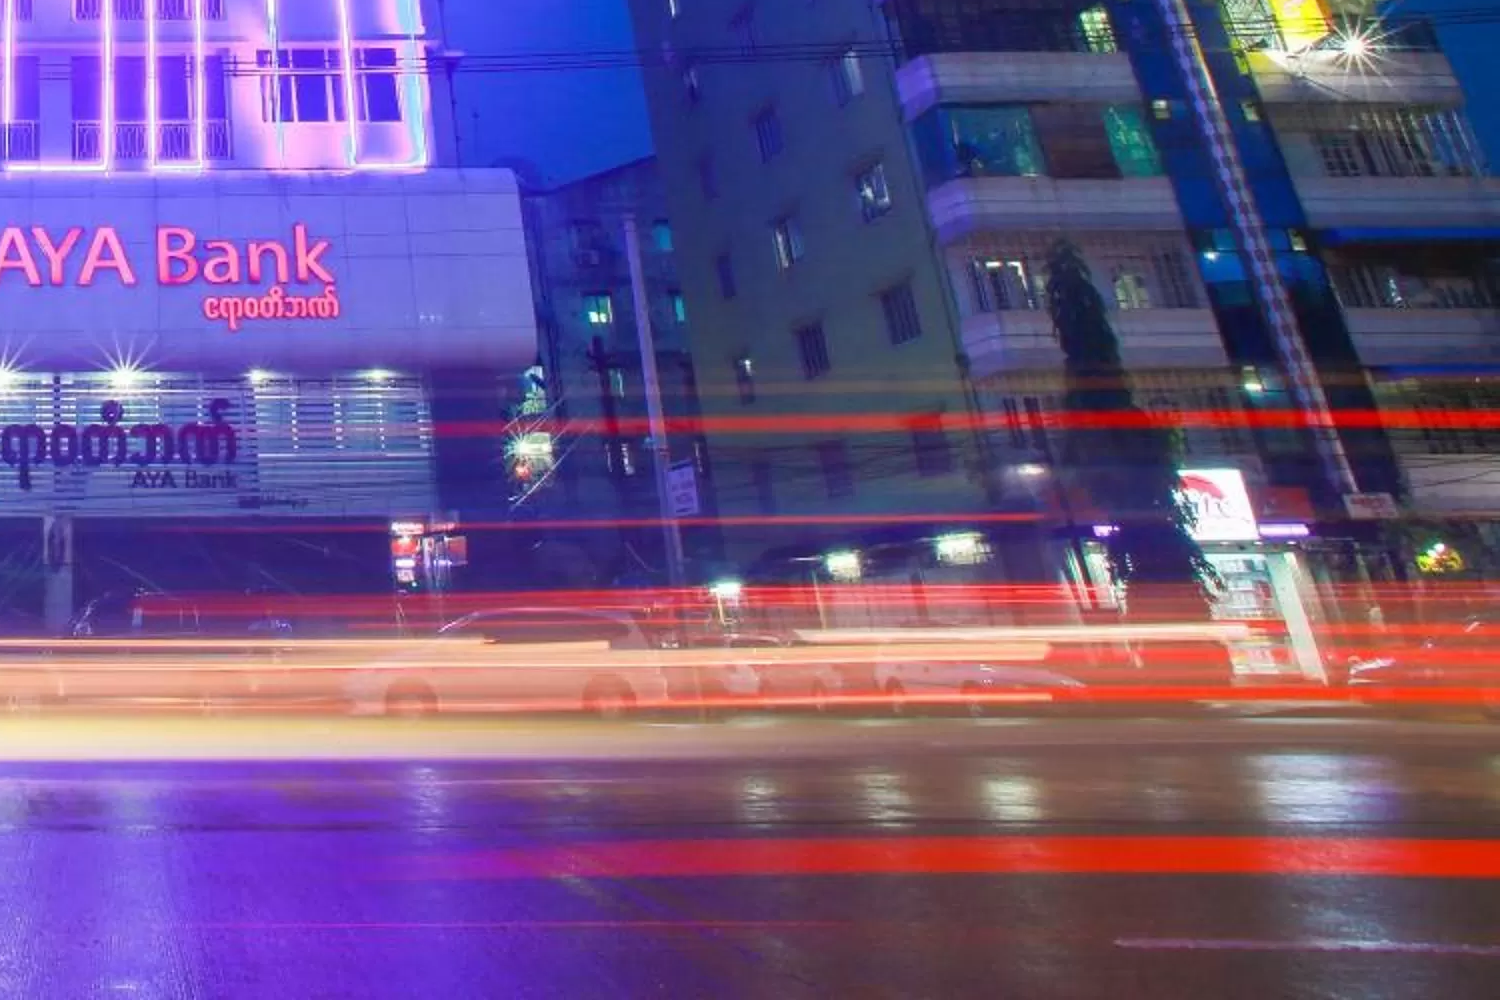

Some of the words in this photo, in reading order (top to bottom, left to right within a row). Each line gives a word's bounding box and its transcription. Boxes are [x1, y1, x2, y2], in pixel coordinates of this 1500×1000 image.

[156, 223, 336, 286] Bank
[132, 470, 177, 488] AYA
[185, 470, 238, 488] Bank
